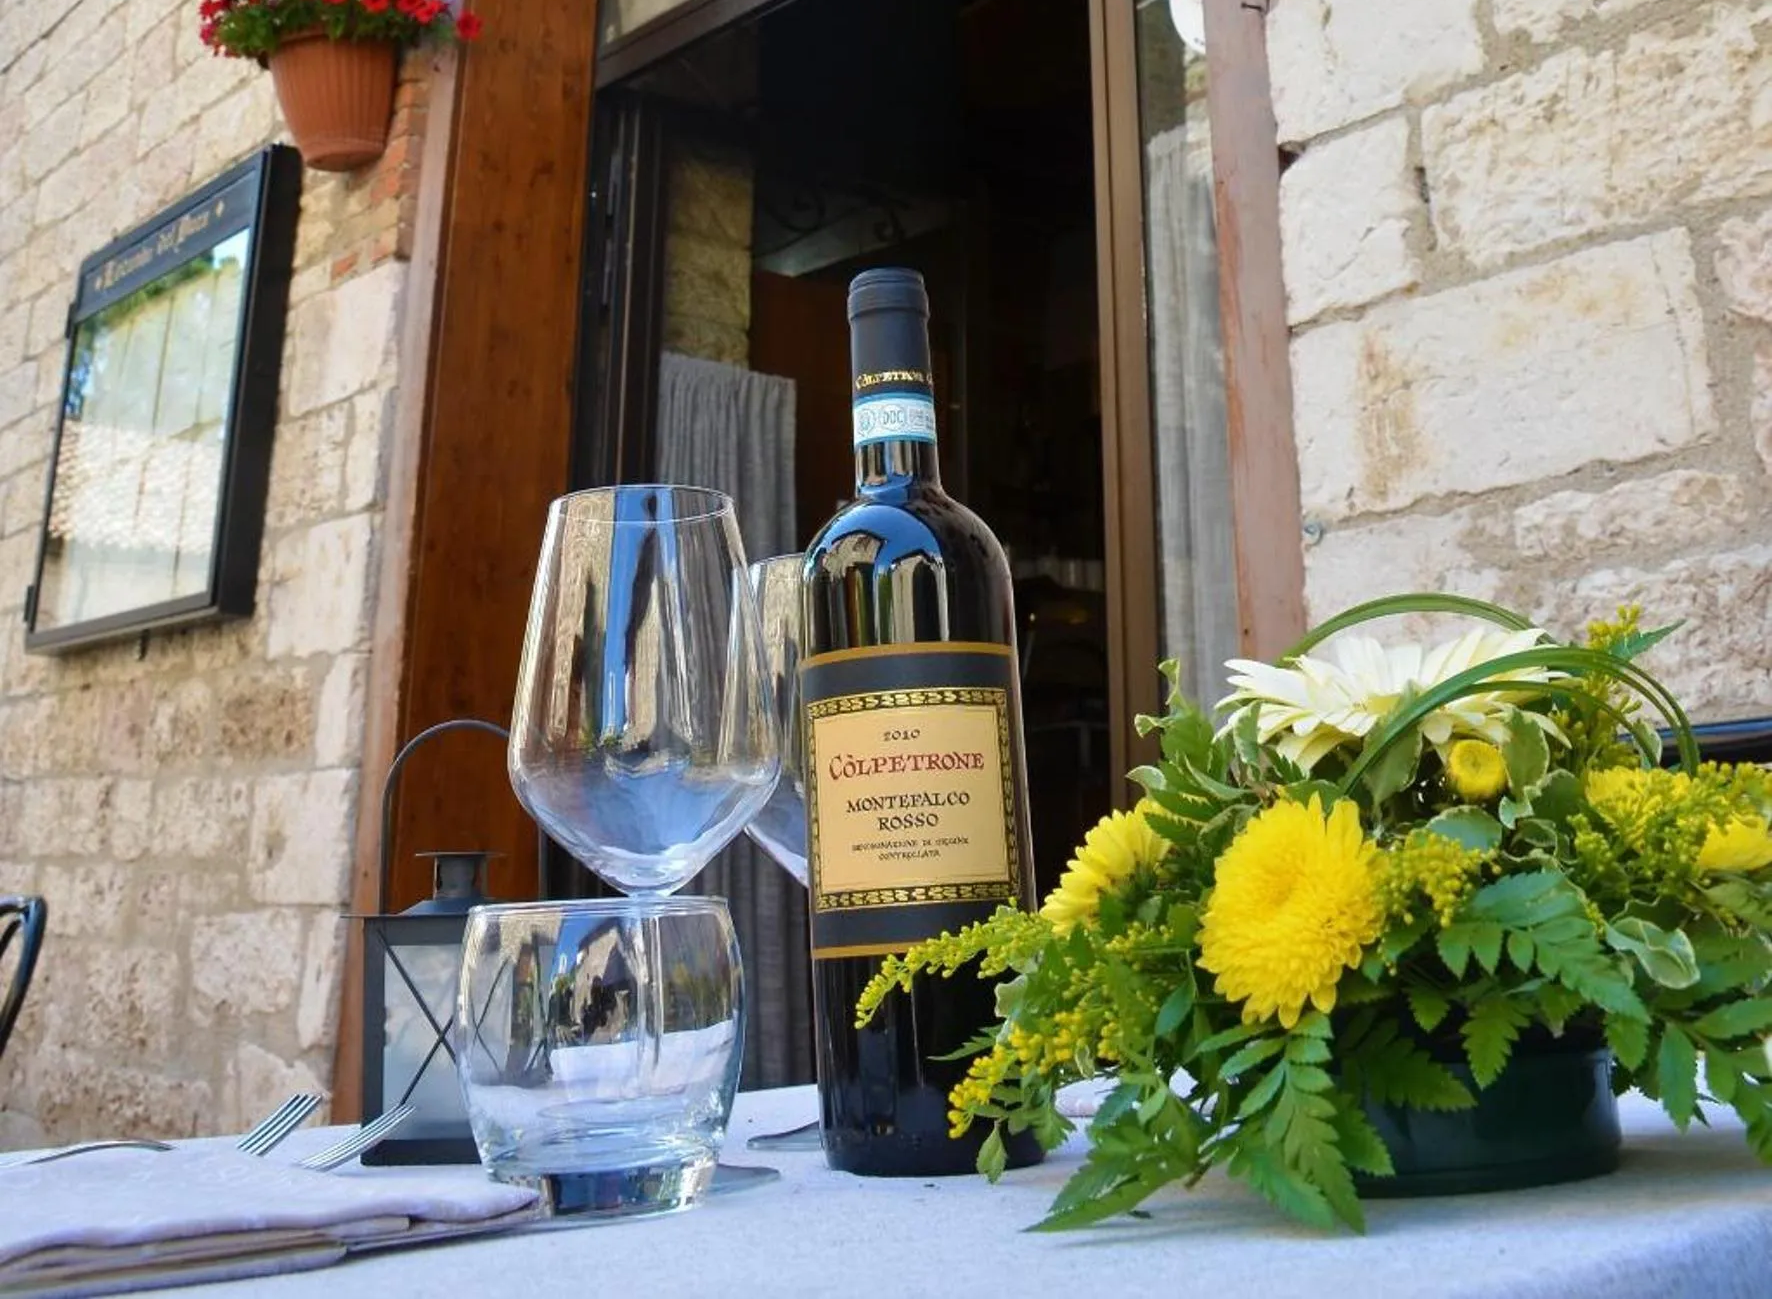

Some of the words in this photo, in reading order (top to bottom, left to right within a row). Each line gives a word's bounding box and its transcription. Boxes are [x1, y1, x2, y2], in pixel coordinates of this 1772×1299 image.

[883, 728, 921, 742] 2010
[828, 750, 985, 781] CÒLPETRONE
[845, 790, 971, 814] MONTEFALCO
[877, 812, 940, 832] ROSSO
